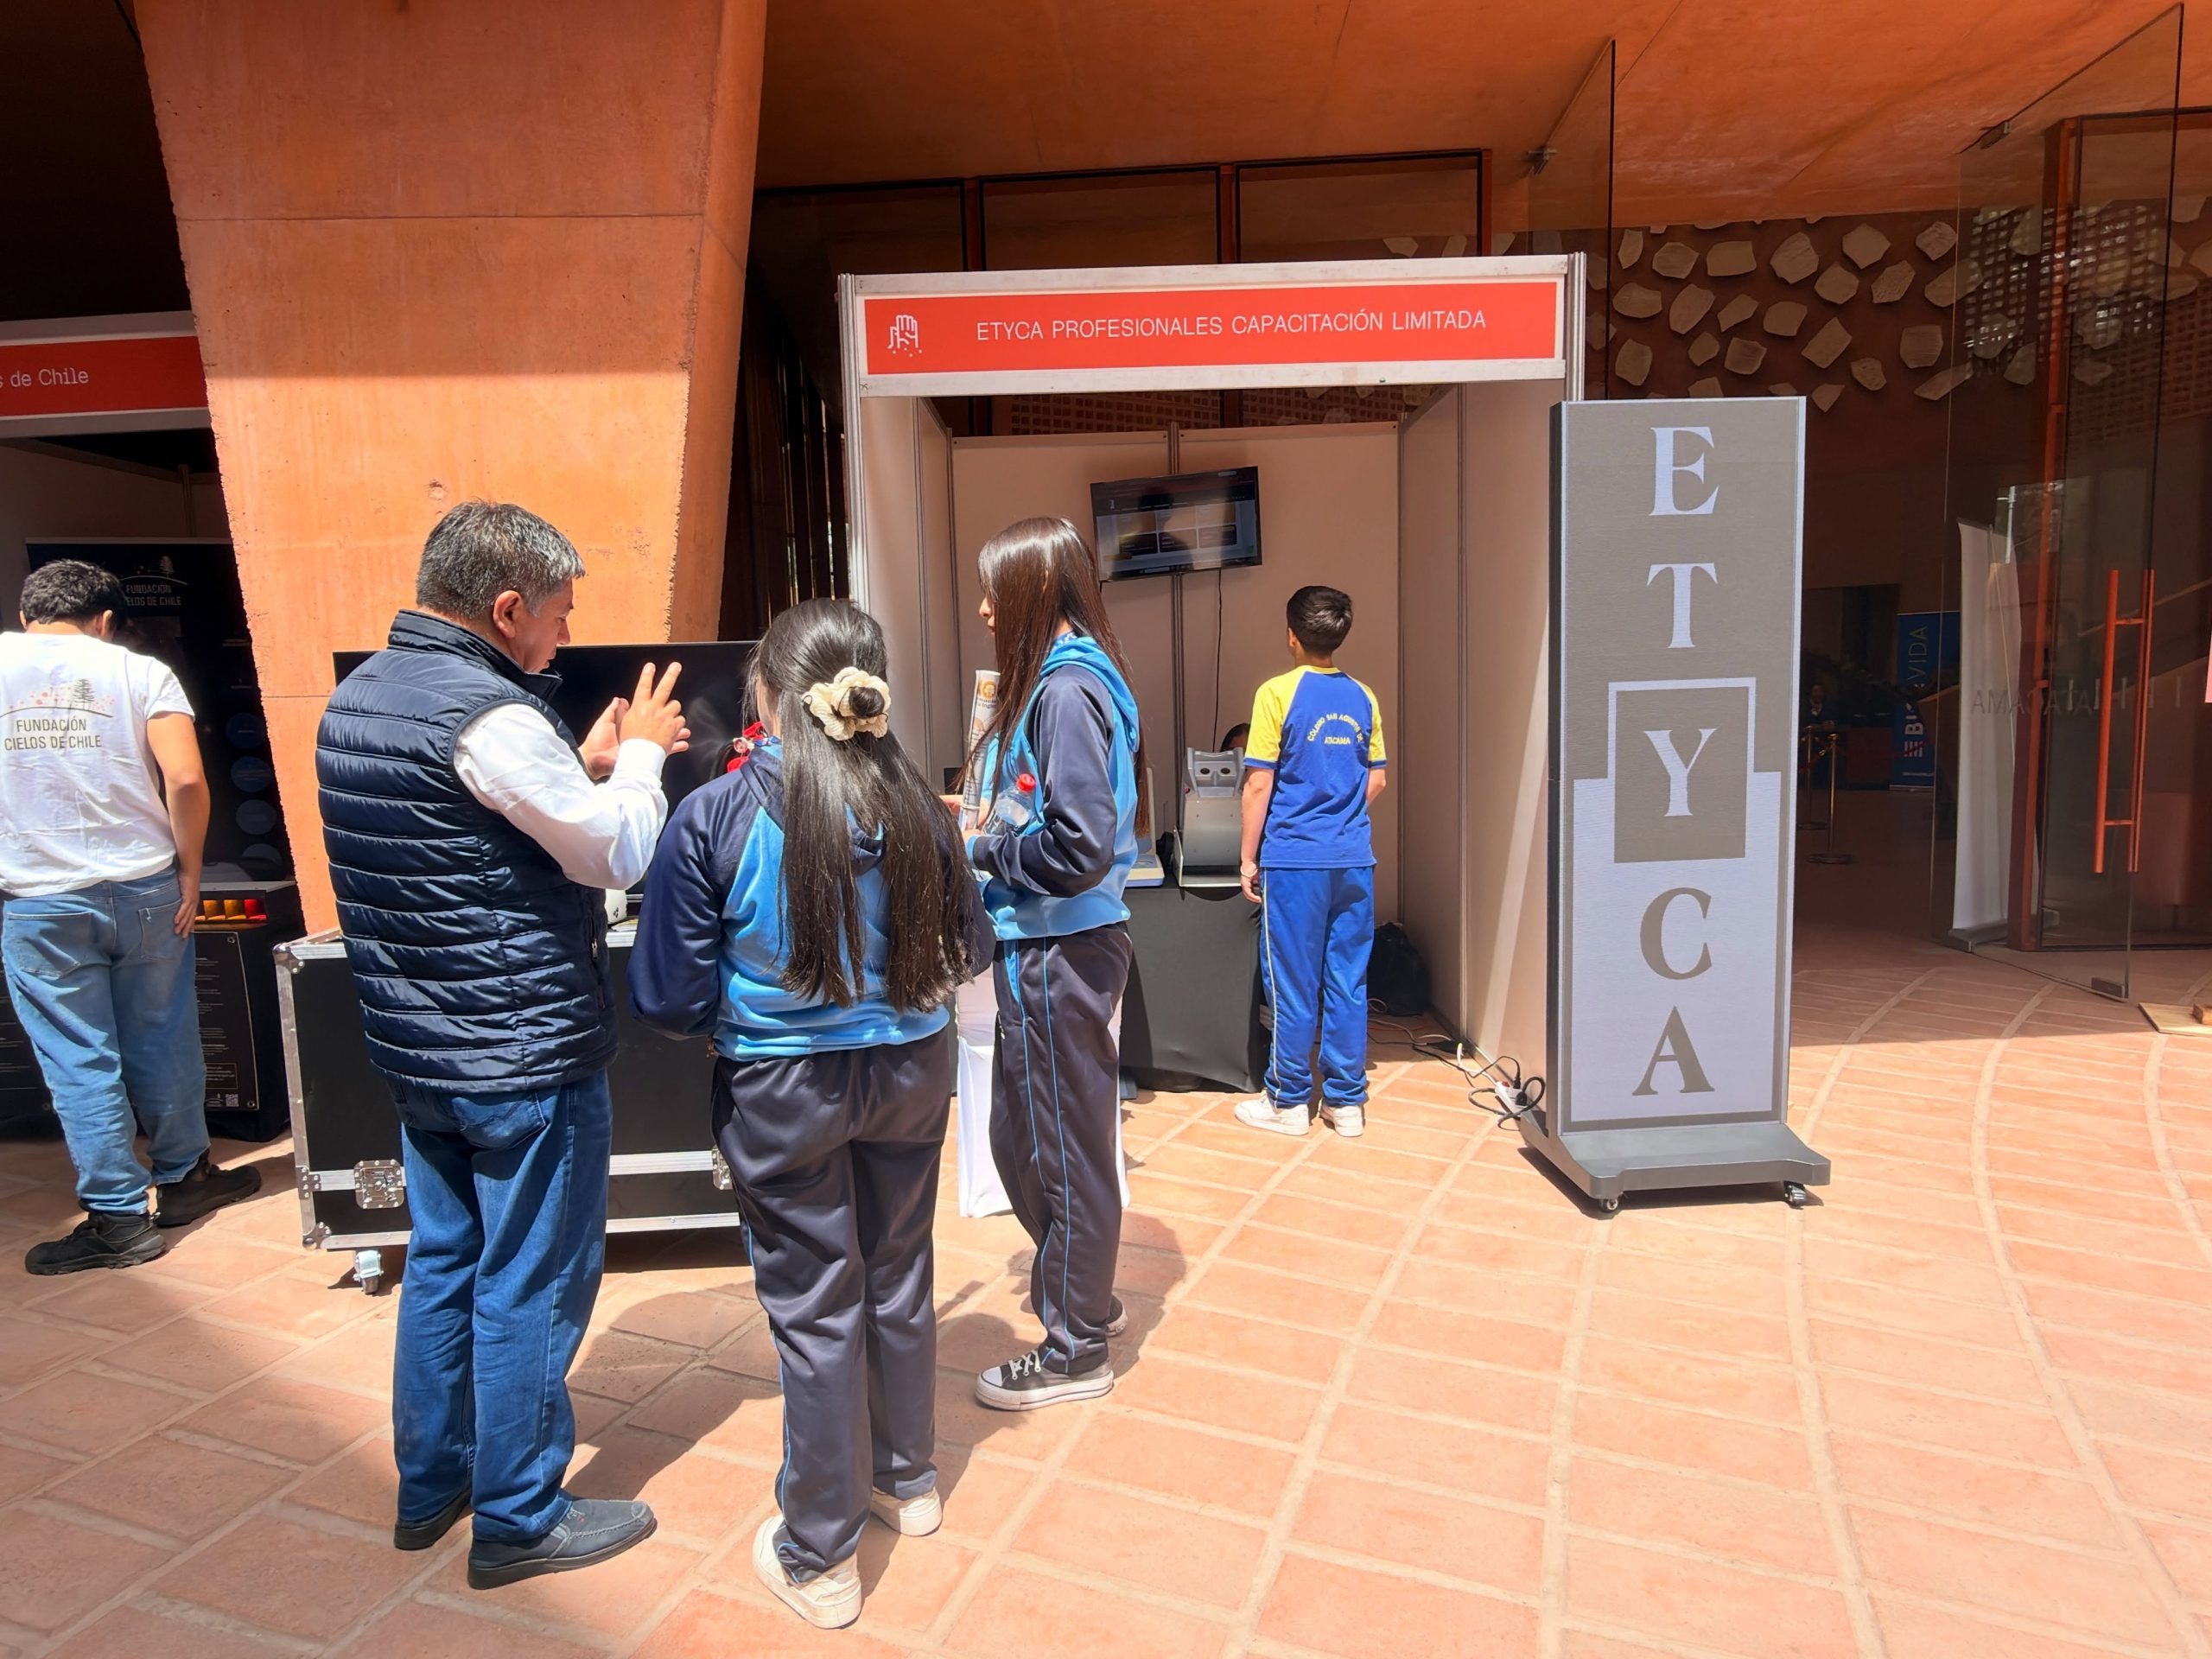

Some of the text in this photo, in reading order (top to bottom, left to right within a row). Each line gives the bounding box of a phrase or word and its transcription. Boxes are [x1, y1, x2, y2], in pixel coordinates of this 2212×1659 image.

[976, 308, 1487, 340] ETYCA PROFESIONALES CAPACITACIÓN LIMITADA
[10, 369, 33, 387] de
[38, 367, 89, 386] Chile
[16, 715, 87, 733] FUNDACIÓN
[3, 734, 103, 751] CIELOS DE CHILE
